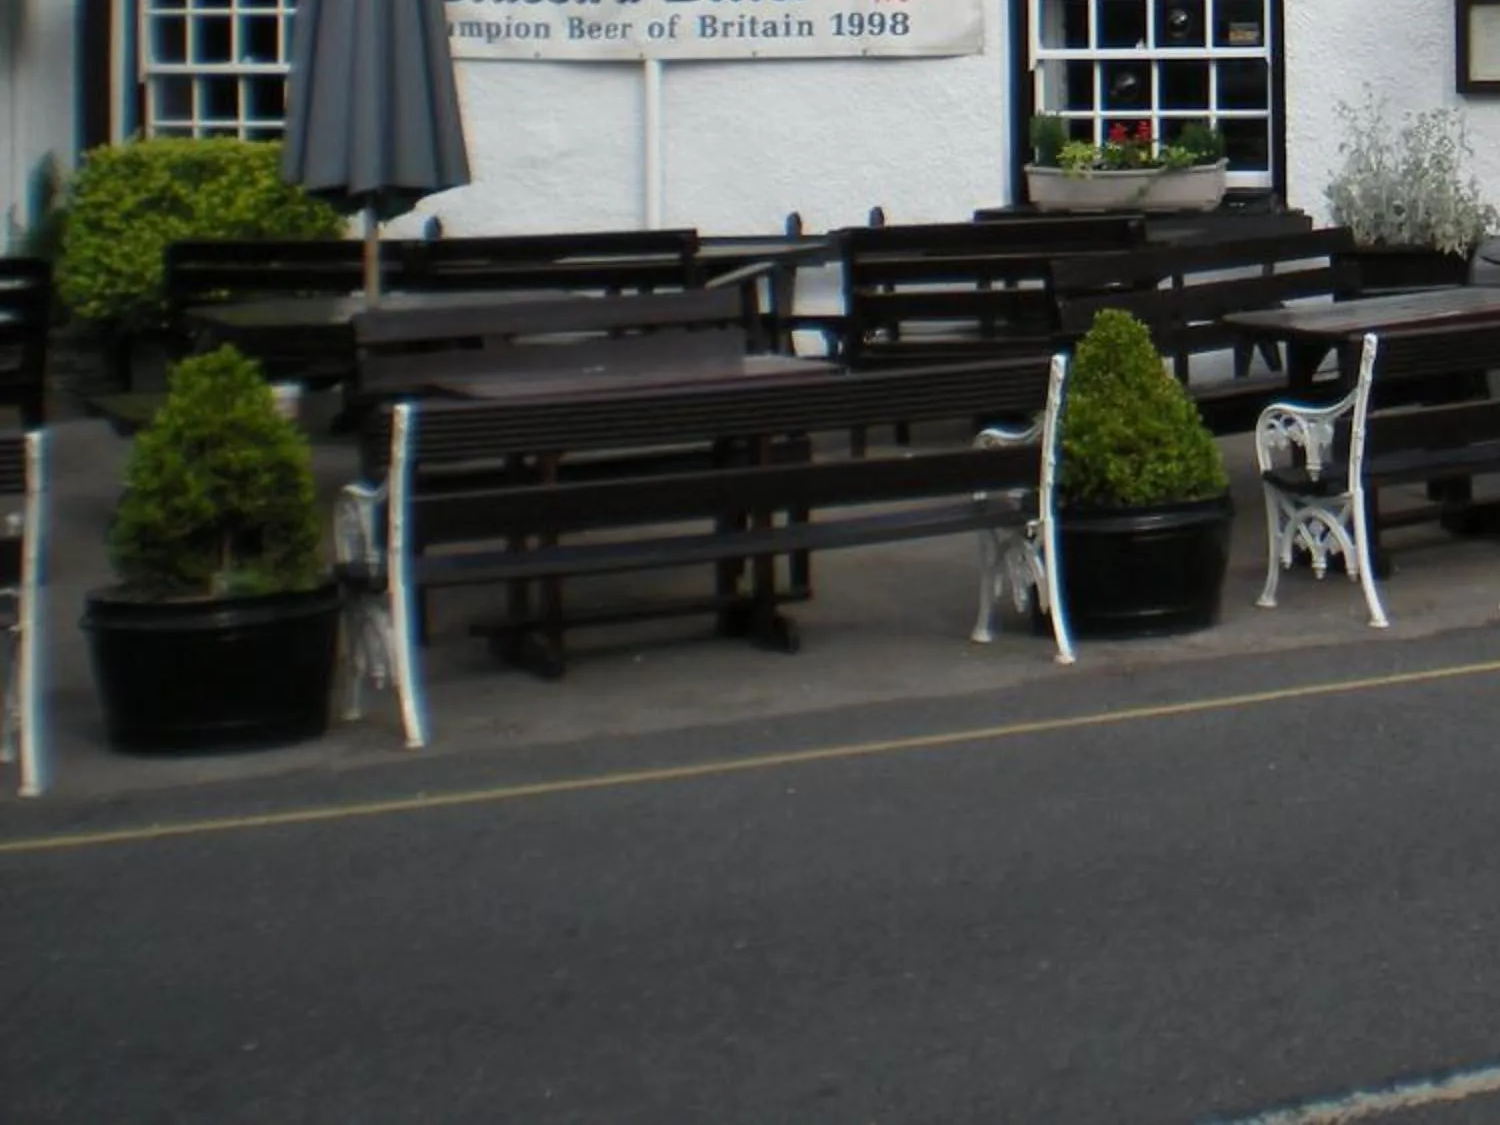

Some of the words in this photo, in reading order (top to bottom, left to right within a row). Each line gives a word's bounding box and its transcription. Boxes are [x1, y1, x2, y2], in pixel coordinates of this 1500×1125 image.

[448, 16, 551, 45] mpion
[568, 16, 633, 41] Beer
[647, 13, 682, 40] of
[697, 13, 815, 39] Britain
[829, 11, 911, 37] 1998
